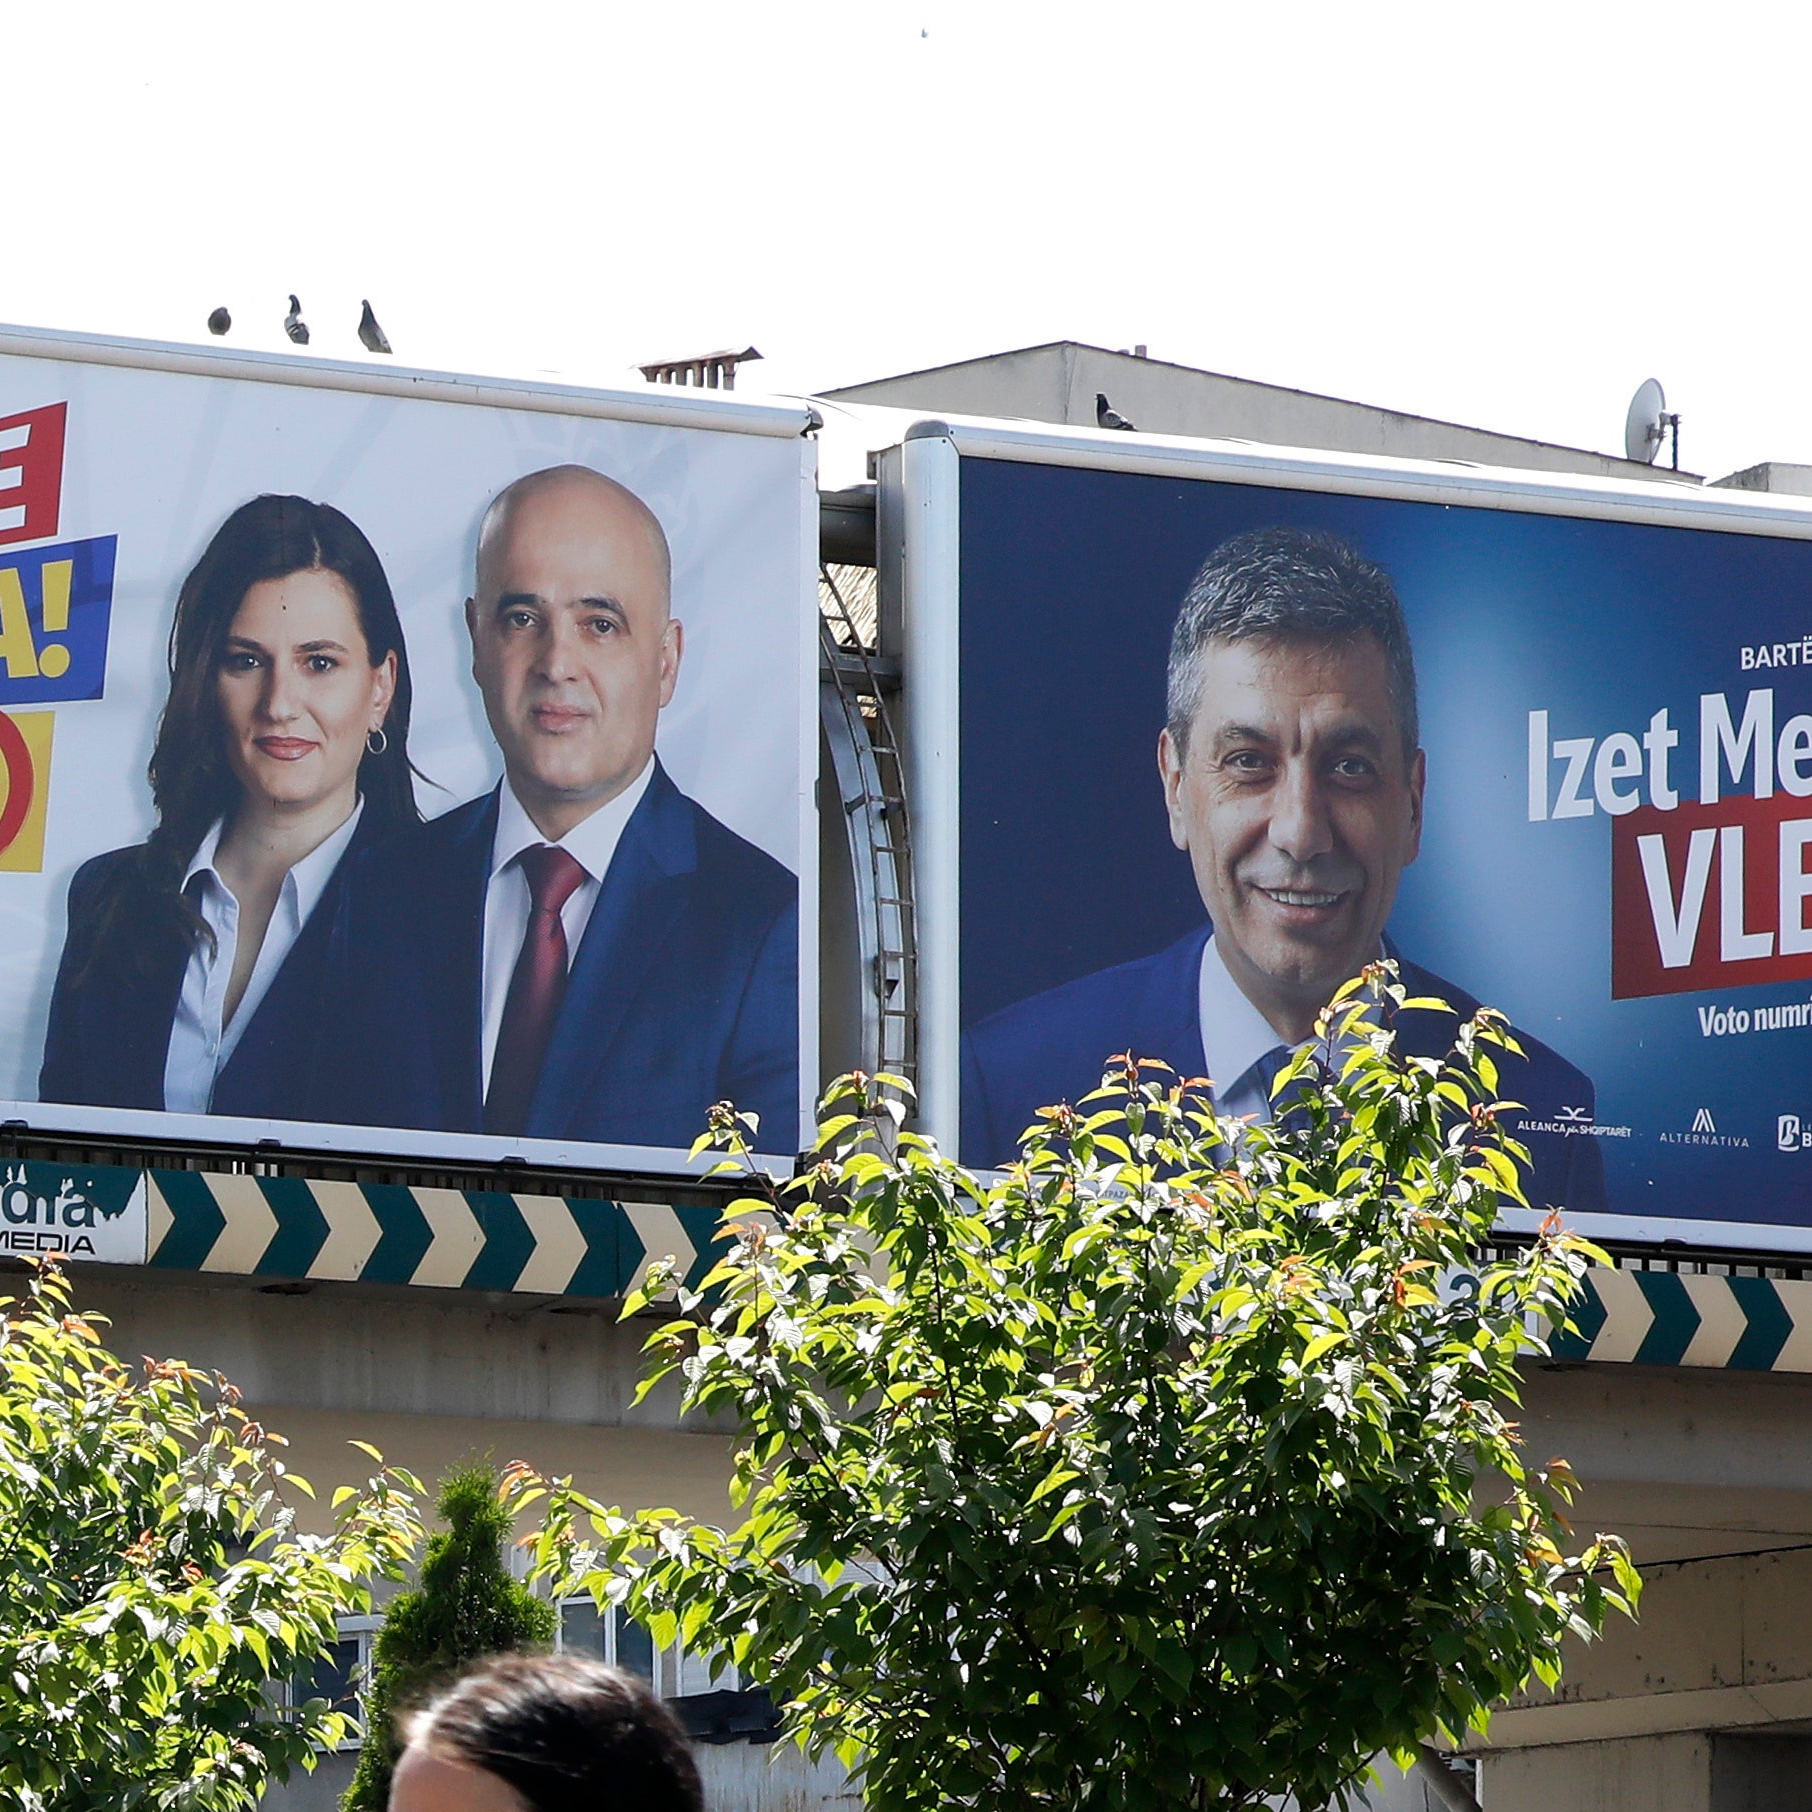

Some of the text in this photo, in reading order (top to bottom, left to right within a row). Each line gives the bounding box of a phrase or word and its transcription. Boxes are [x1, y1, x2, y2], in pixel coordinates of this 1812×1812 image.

[1741, 635, 1812, 670] BARTË
[1528, 688, 1812, 822] Izet Me
[1637, 818, 1812, 970] VLE
[1698, 1005, 1750, 1037] Voto
[1517, 1119, 1566, 1134] ALEANCA
[1659, 1132, 1750, 1148] ALTERNATIVA
